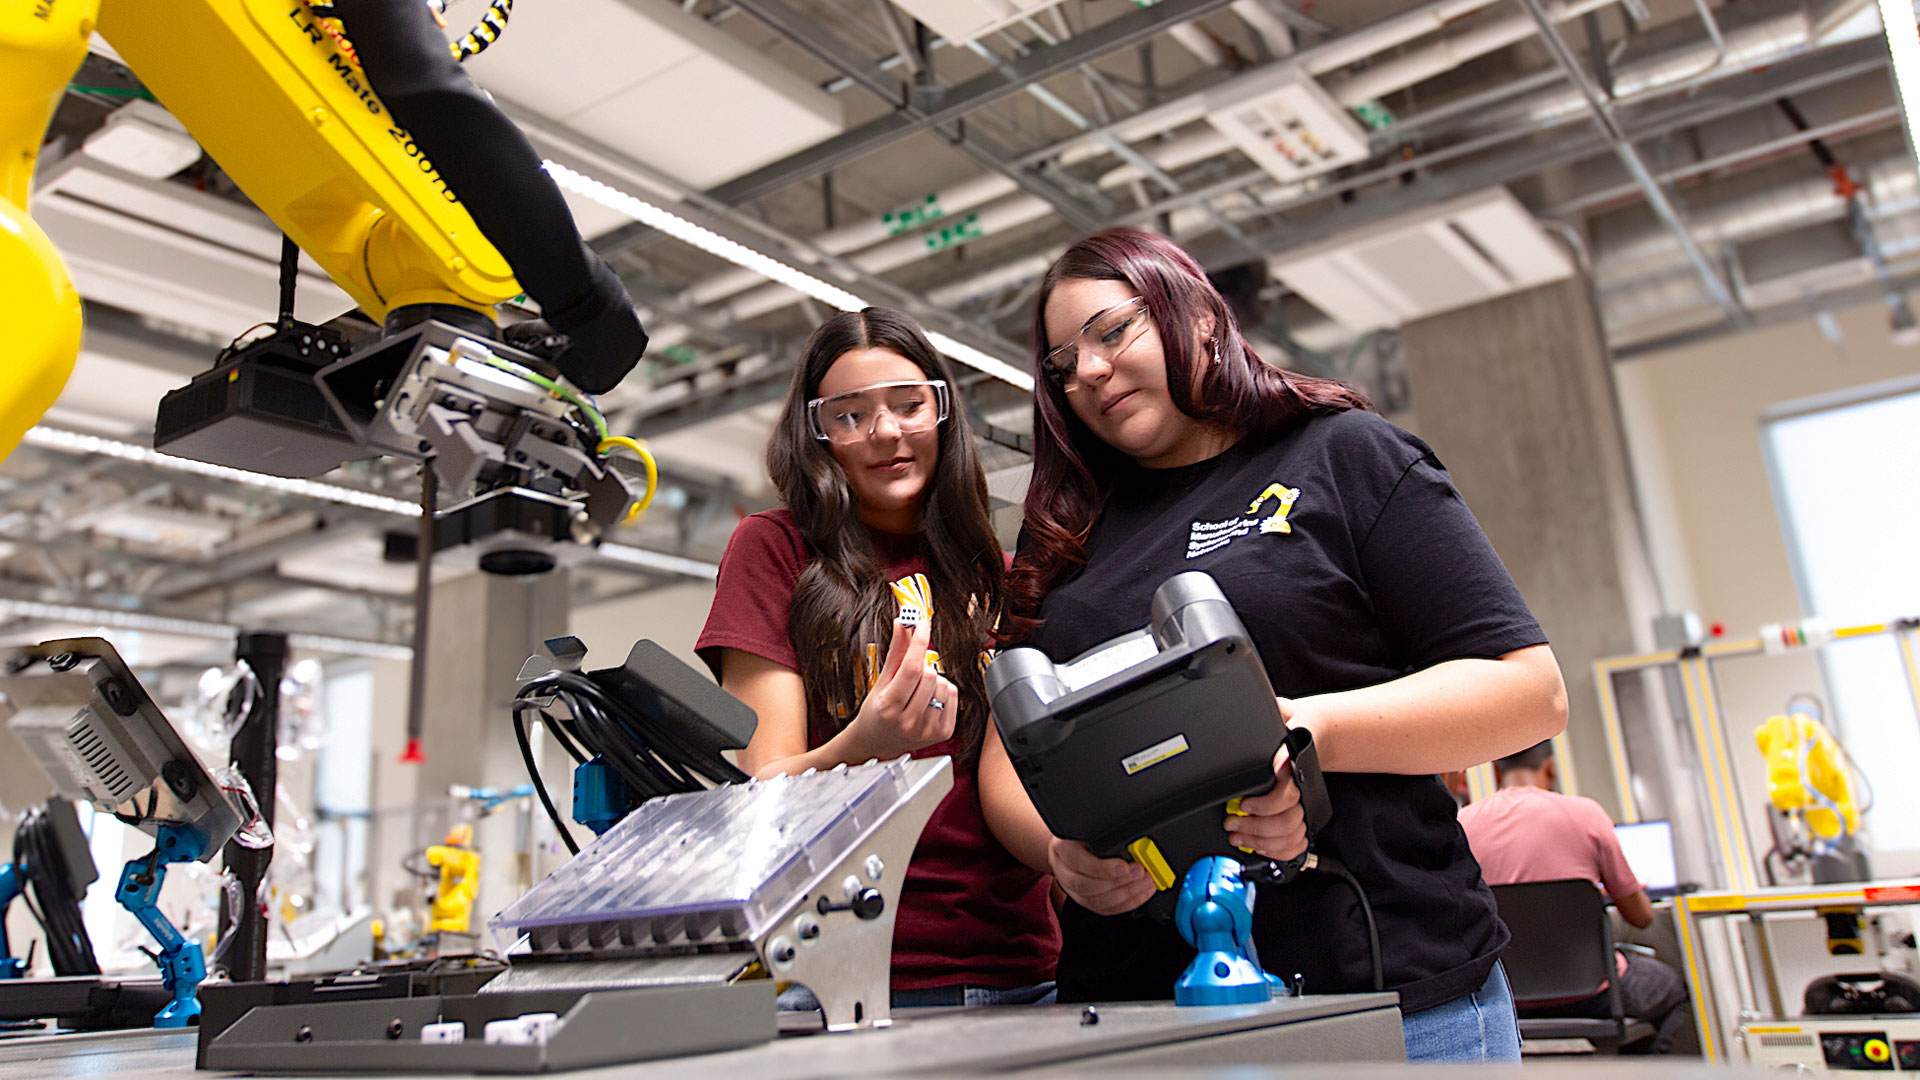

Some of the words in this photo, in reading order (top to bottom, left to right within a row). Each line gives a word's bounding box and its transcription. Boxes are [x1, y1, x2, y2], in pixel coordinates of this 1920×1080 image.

[290, 8, 323, 44] LR
[328, 53, 380, 114] Mate
[1191, 519, 1229, 532] School
[1228, 516, 1240, 527] of
